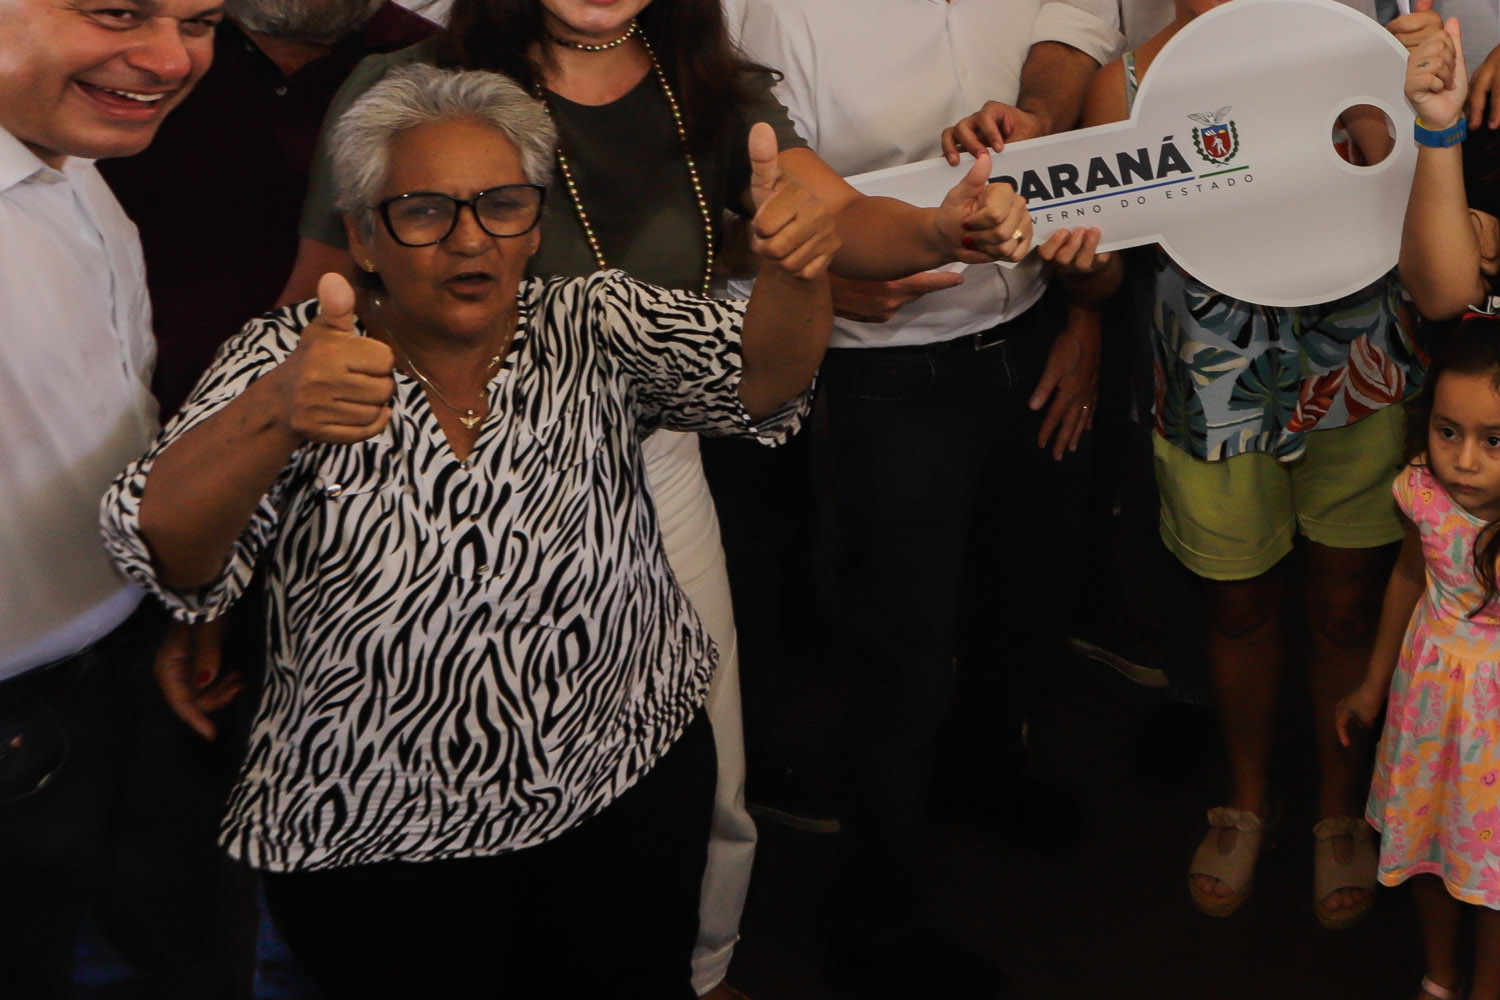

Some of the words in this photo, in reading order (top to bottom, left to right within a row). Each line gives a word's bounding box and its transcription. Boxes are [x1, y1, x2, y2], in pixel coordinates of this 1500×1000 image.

[1031, 204, 1101, 225] VERNO
[1121, 196, 1146, 208] DO
[1166, 174, 1253, 199] ESTADO
